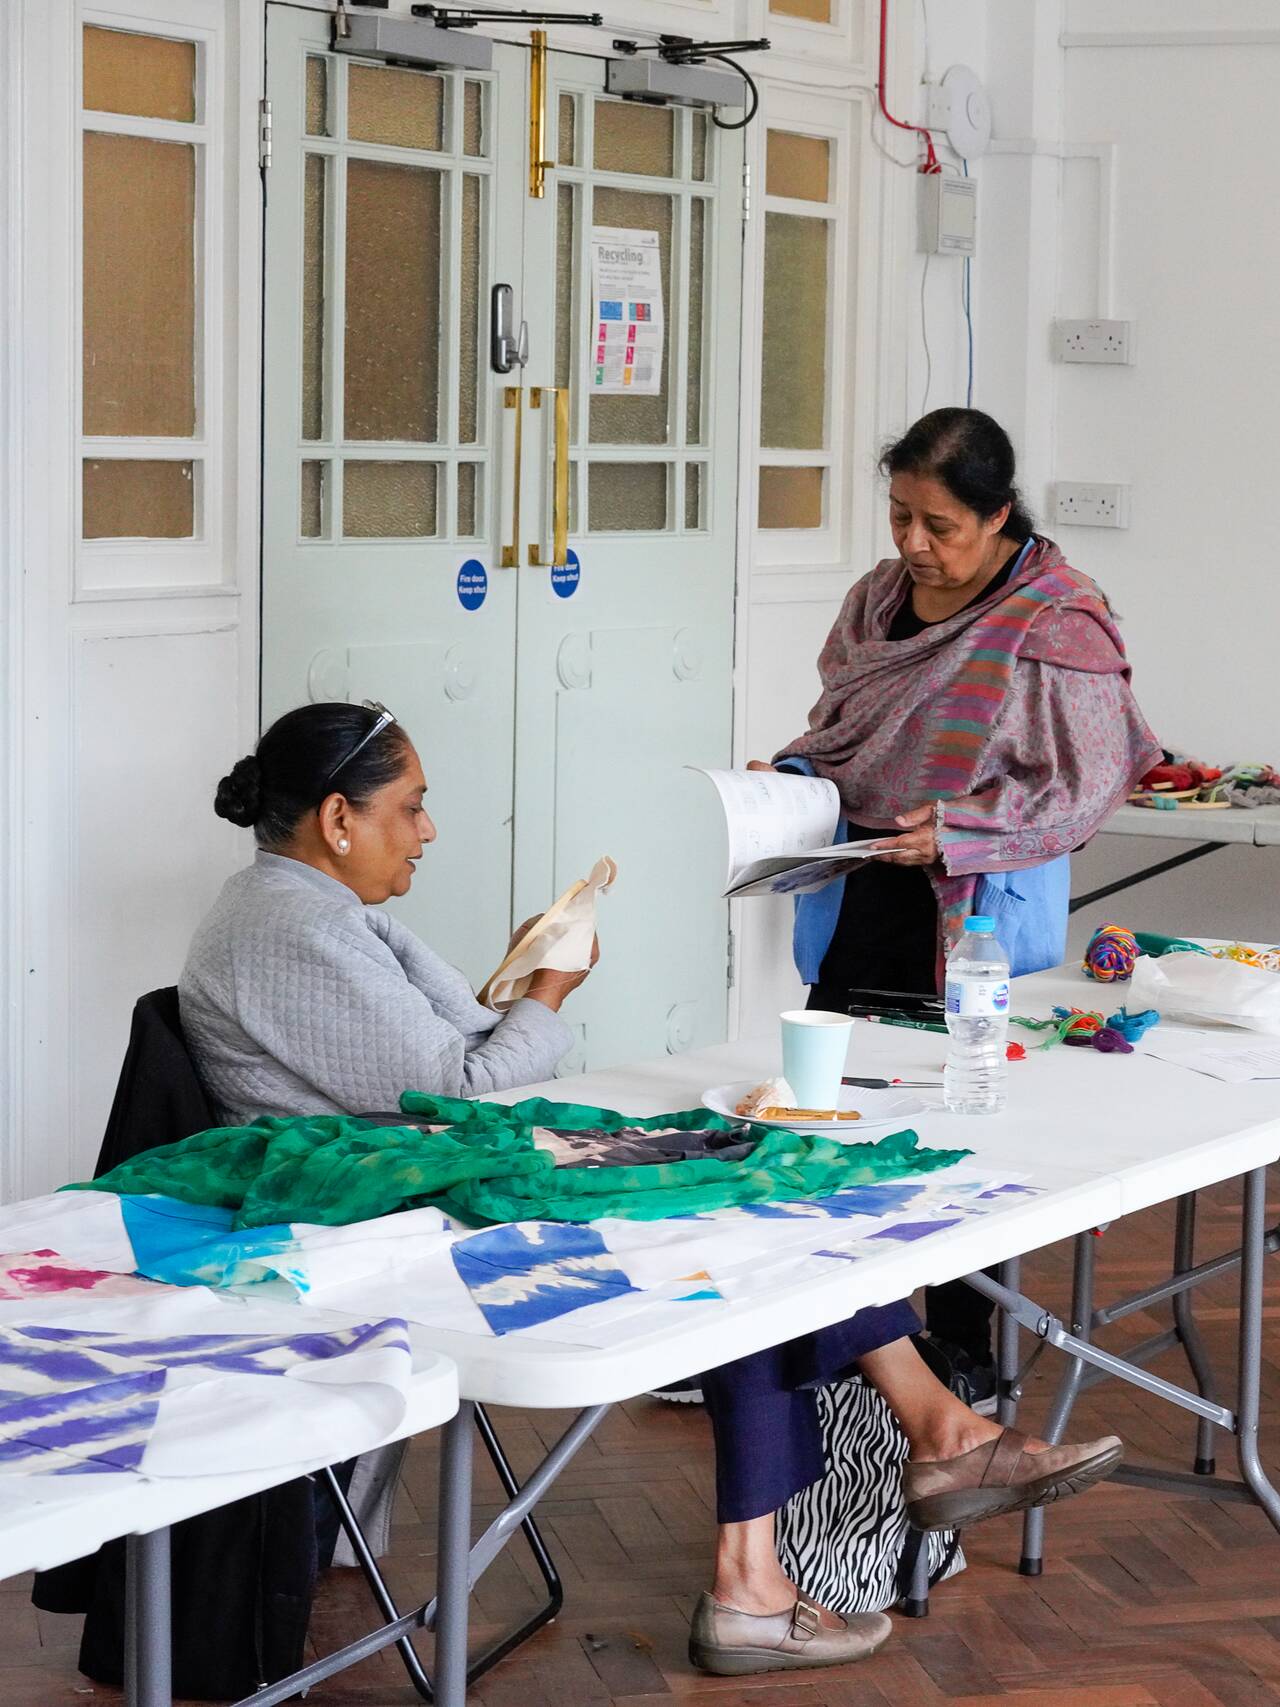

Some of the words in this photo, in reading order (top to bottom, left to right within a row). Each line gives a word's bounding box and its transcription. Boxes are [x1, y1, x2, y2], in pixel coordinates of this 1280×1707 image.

[598, 246, 643, 266] Recycling
[460, 575, 471, 583] Fire
[471, 575, 485, 583] door
[553, 574, 566, 583] Keep
[566, 573, 579, 581] shut
[459, 585, 473, 595] Keep
[473, 585, 486, 593] shut
